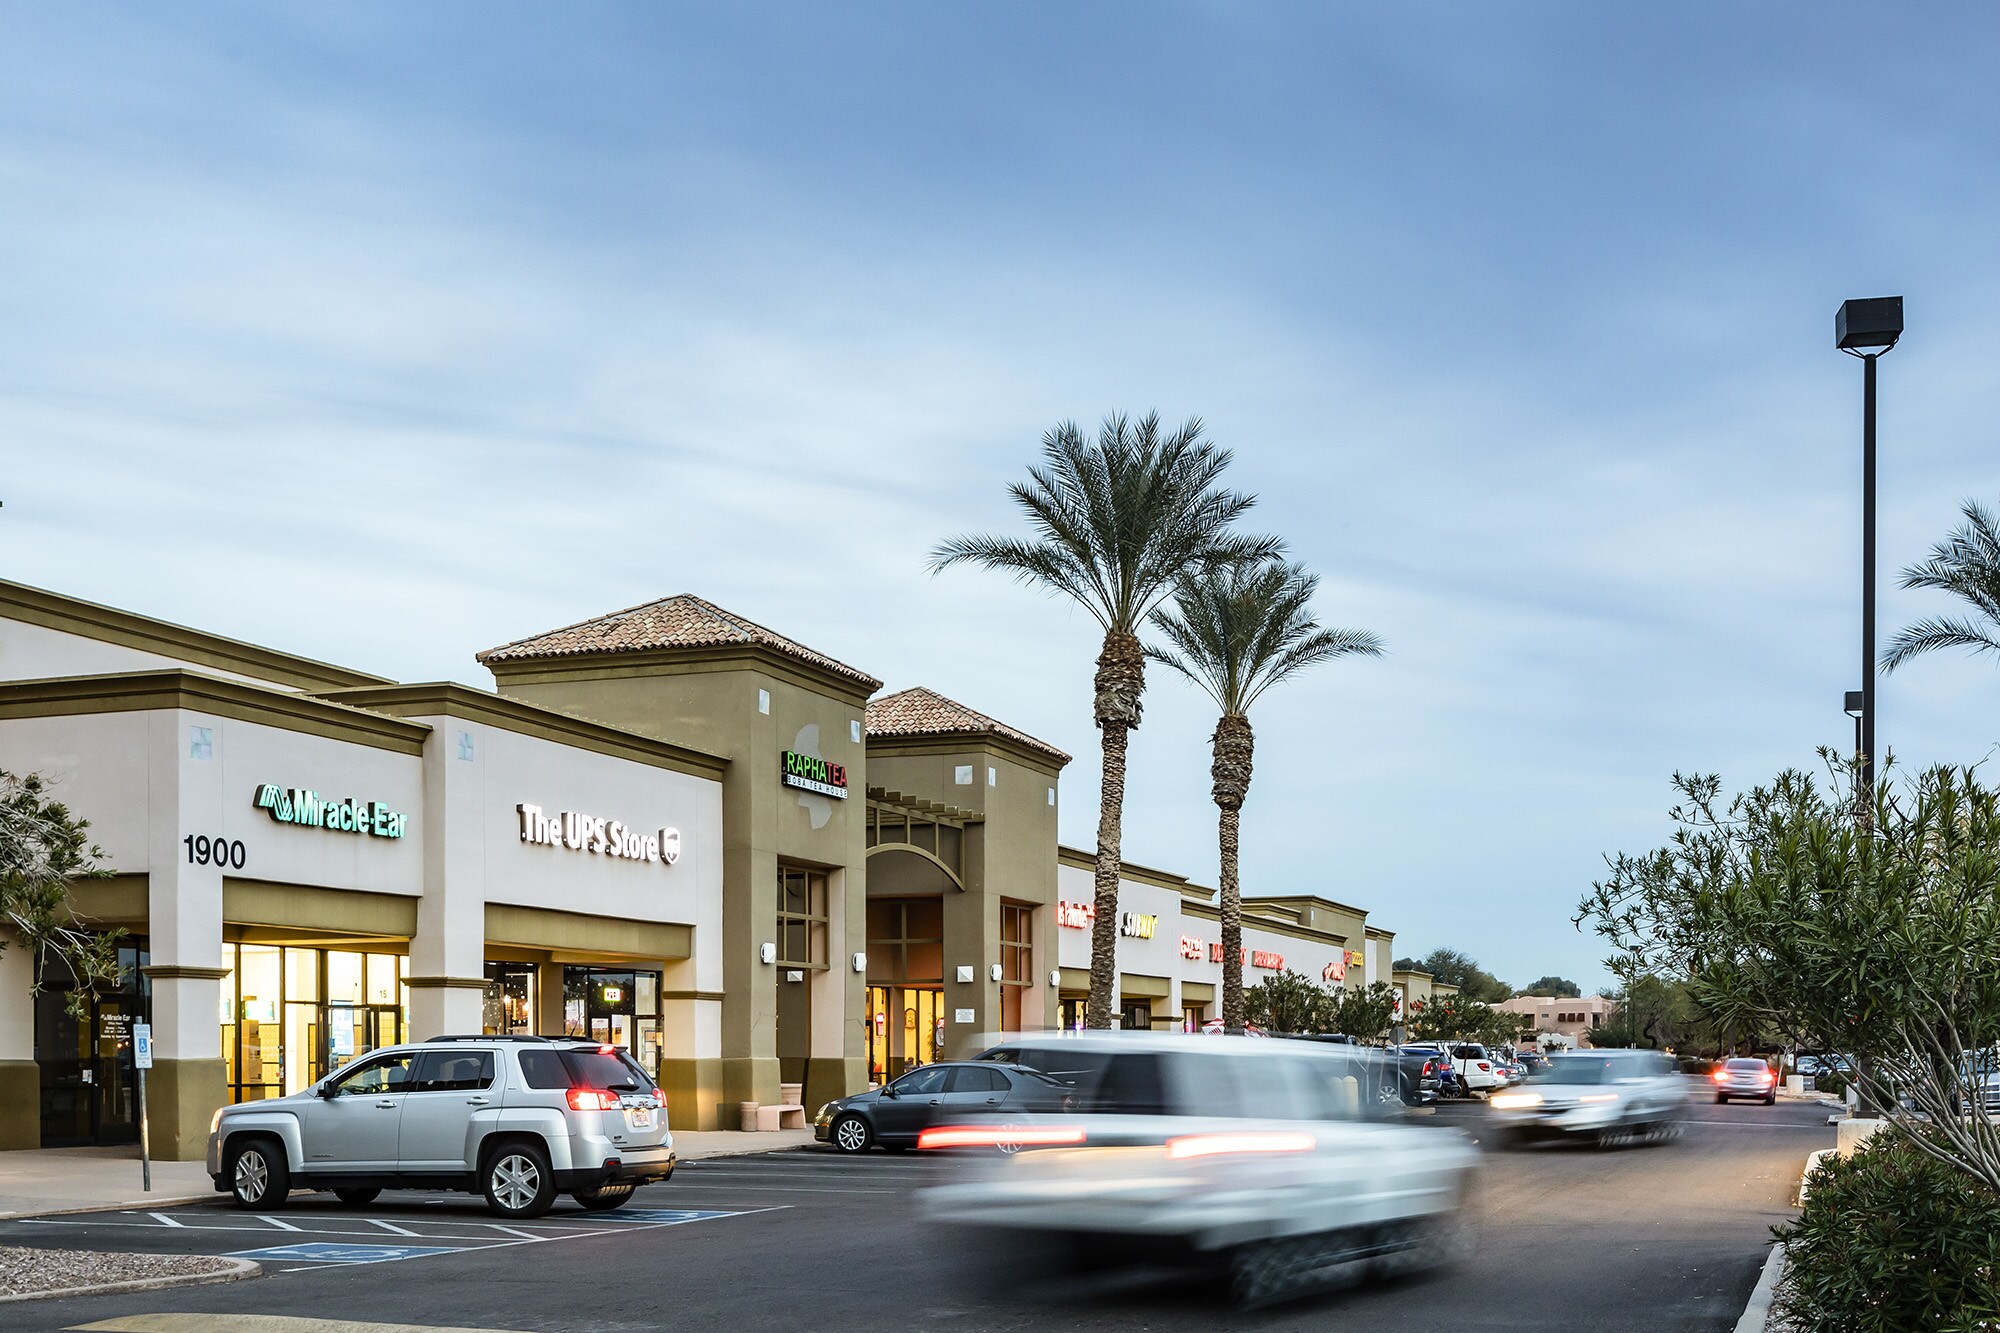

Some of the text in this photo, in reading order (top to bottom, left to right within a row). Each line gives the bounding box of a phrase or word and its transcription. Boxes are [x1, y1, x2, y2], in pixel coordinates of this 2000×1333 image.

[787, 775, 847, 798] BOBA TEA HOUSE
[290, 788, 408, 838] Miracle-Ear
[517, 803, 658, 862] The UPS Store
[183, 834, 246, 870] 1900
[1122, 912, 1158, 939] SUBWAY
[111, 978, 121, 987] 13
[379, 990, 388, 999] 15
